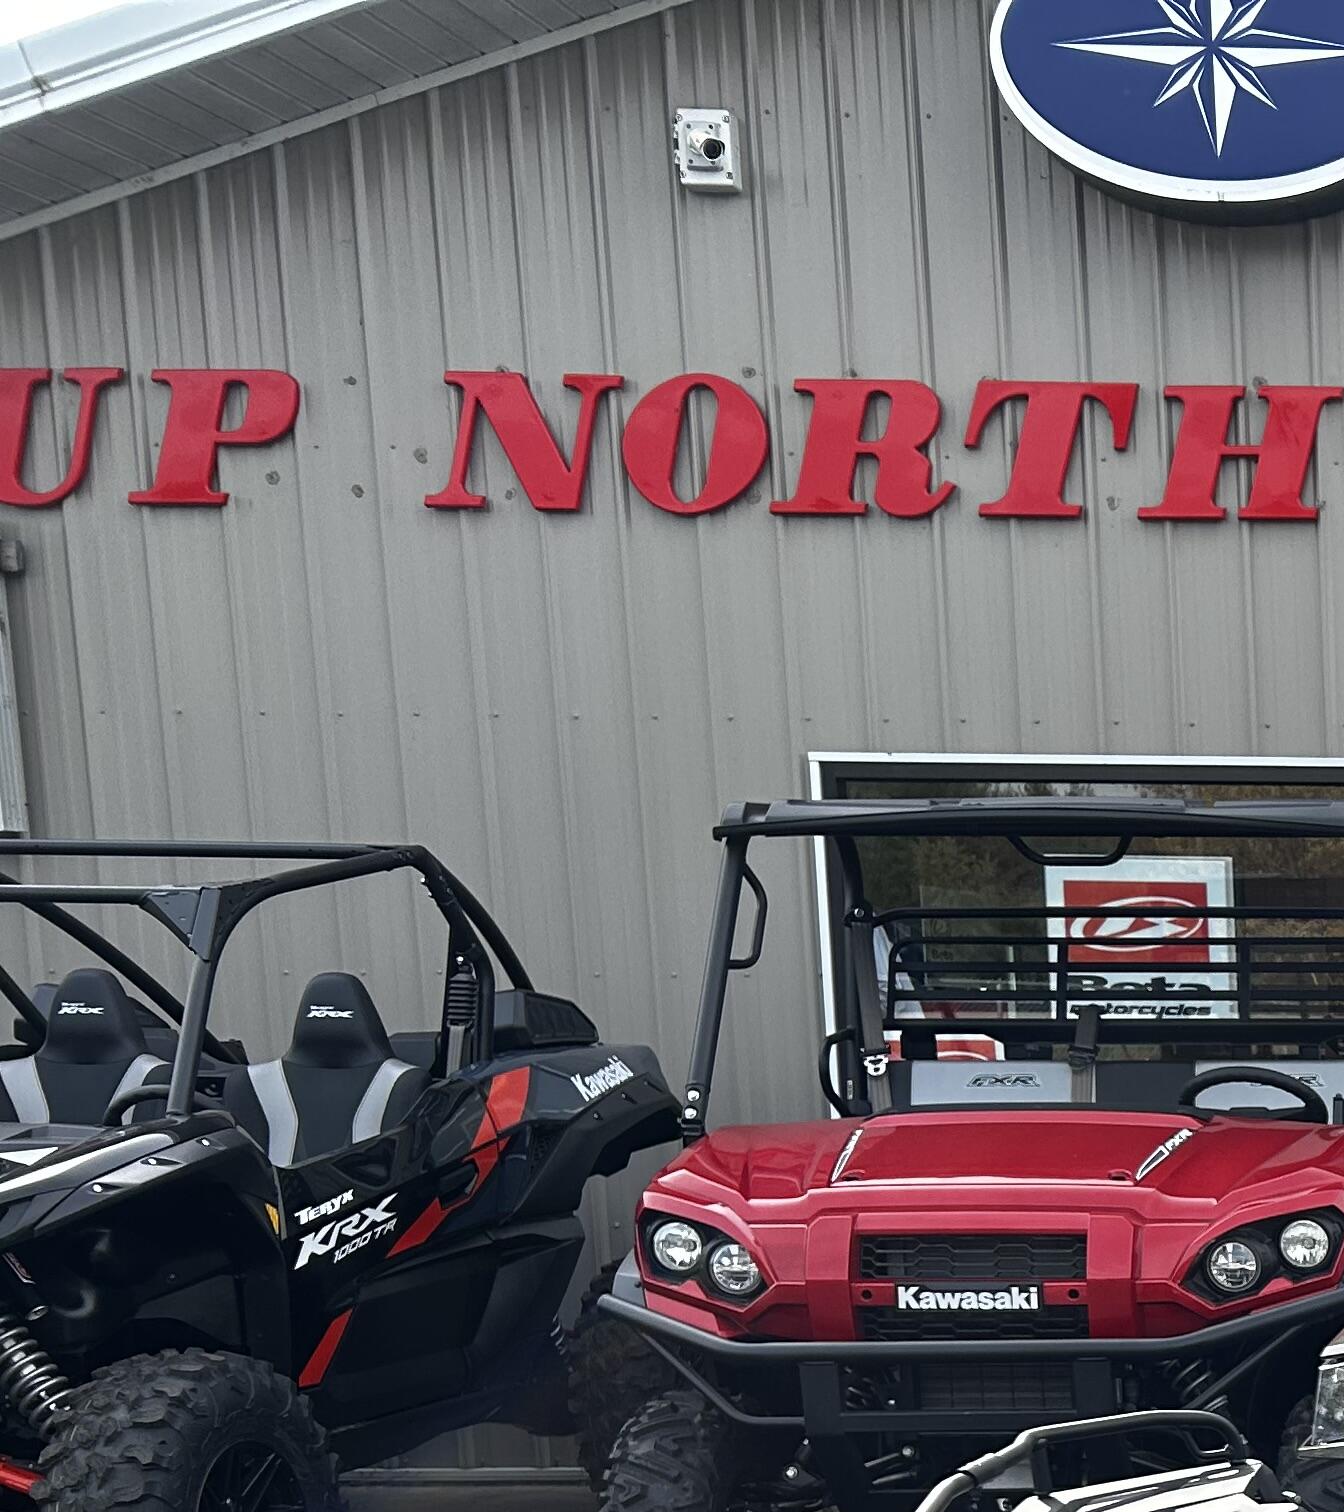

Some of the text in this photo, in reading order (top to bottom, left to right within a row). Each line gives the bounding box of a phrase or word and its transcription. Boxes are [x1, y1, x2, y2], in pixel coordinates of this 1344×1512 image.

[0, 366, 300, 508] UP
[424, 371, 1344, 523] NORTH
[570, 1054, 634, 1102] Kawasaki
[294, 1191, 399, 1270] KRX
[333, 1230, 373, 1264] 1000
[897, 1286, 1039, 1310] Kawasaki
